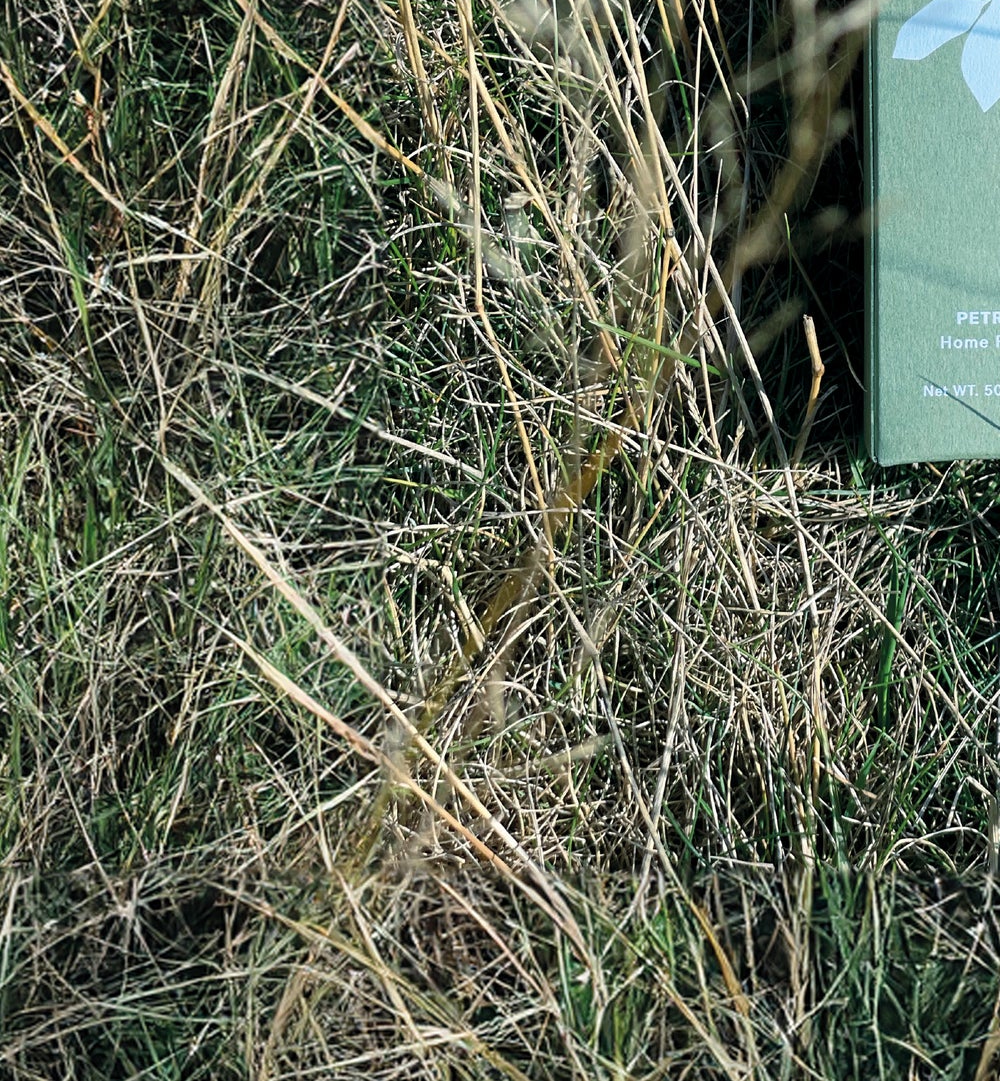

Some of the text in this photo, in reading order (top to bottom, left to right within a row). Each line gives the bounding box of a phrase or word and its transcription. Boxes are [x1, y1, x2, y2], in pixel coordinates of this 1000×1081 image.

[940, 336, 989, 349] Home
[923, 384, 948, 397] Net
[953, 385, 979, 397] WT.
